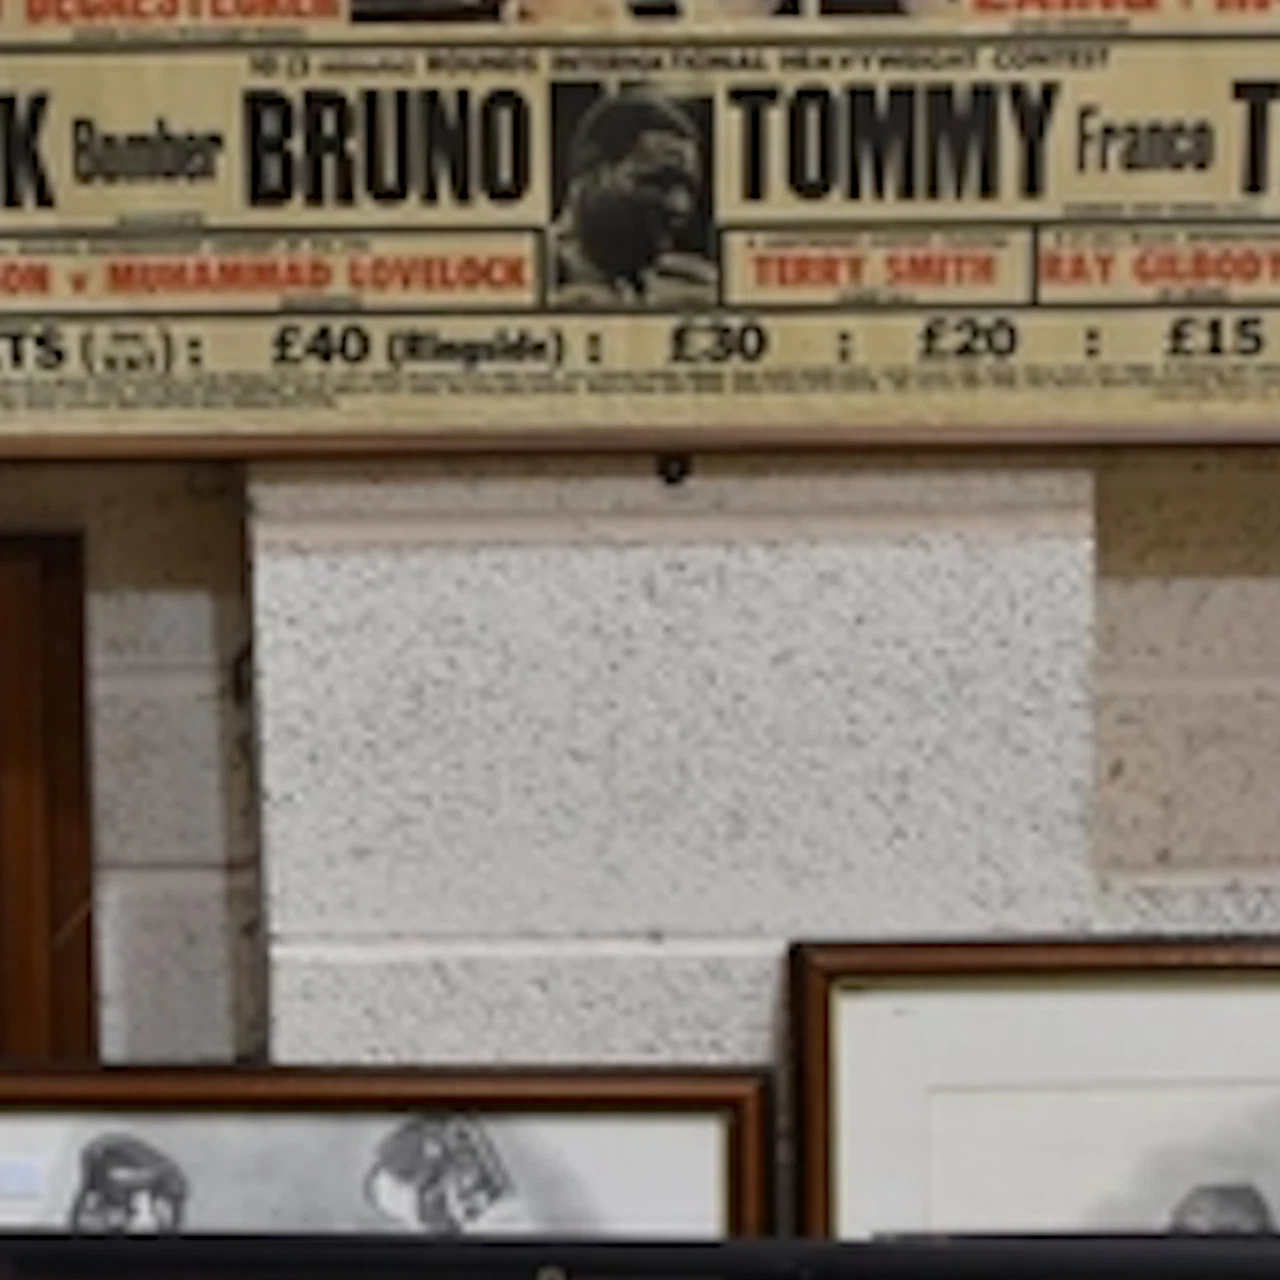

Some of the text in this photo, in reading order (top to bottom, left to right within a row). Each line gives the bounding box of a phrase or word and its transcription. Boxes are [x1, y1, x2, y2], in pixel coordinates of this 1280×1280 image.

[779, 46, 977, 72] HEAVYWEIGHT
[993, 46, 1110, 71] CONTEST
[72, 118, 224, 184] Bomber
[242, 87, 532, 207] BRUNO
[726, 81, 1061, 201] TOMMY
[1076, 105, 1216, 173] Franco
[106, 258, 334, 296] MUHAMMAD
[349, 255, 532, 290] LOVELOCK
[750, 252, 998, 288] TERRY SMITH
[1039, 249, 1114, 286] RAY
[272, 324, 372, 364] £40
[388, 328, 565, 368] (Ringside)
[669, 322, 770, 364] £30
[921, 320, 1018, 358] £20
[1165, 315, 1265, 356] £15
